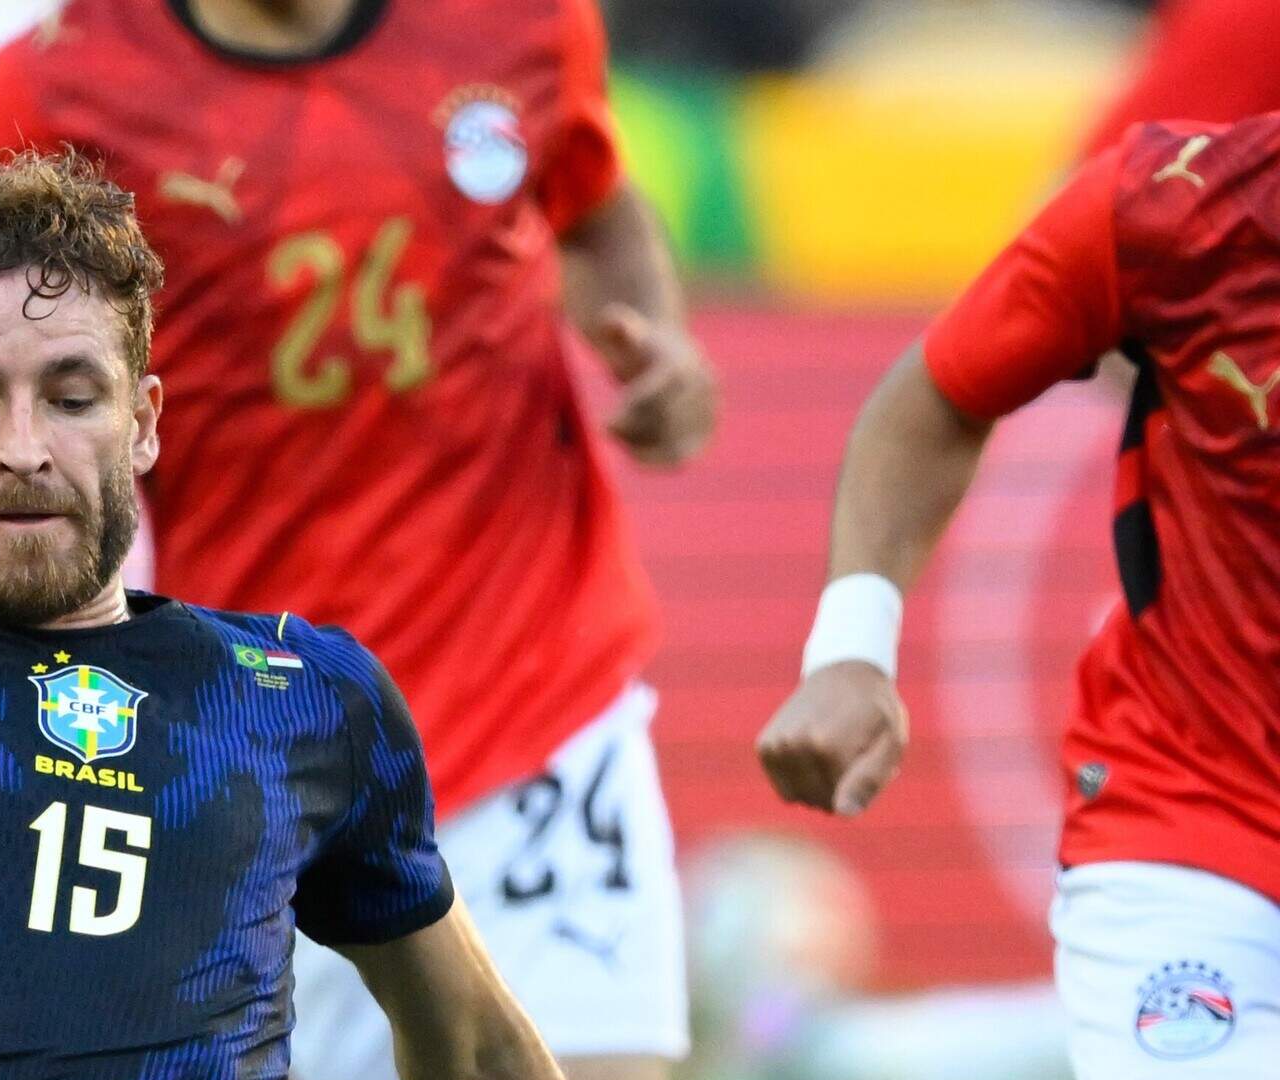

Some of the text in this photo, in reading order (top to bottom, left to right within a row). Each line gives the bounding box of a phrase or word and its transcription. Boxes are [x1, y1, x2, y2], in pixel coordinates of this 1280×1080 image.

[264, 217, 433, 407] 24
[34, 755, 144, 792] BRASIL
[69, 701, 108, 715] CBF
[27, 801, 152, 936] 15
[500, 740, 631, 906] 24
